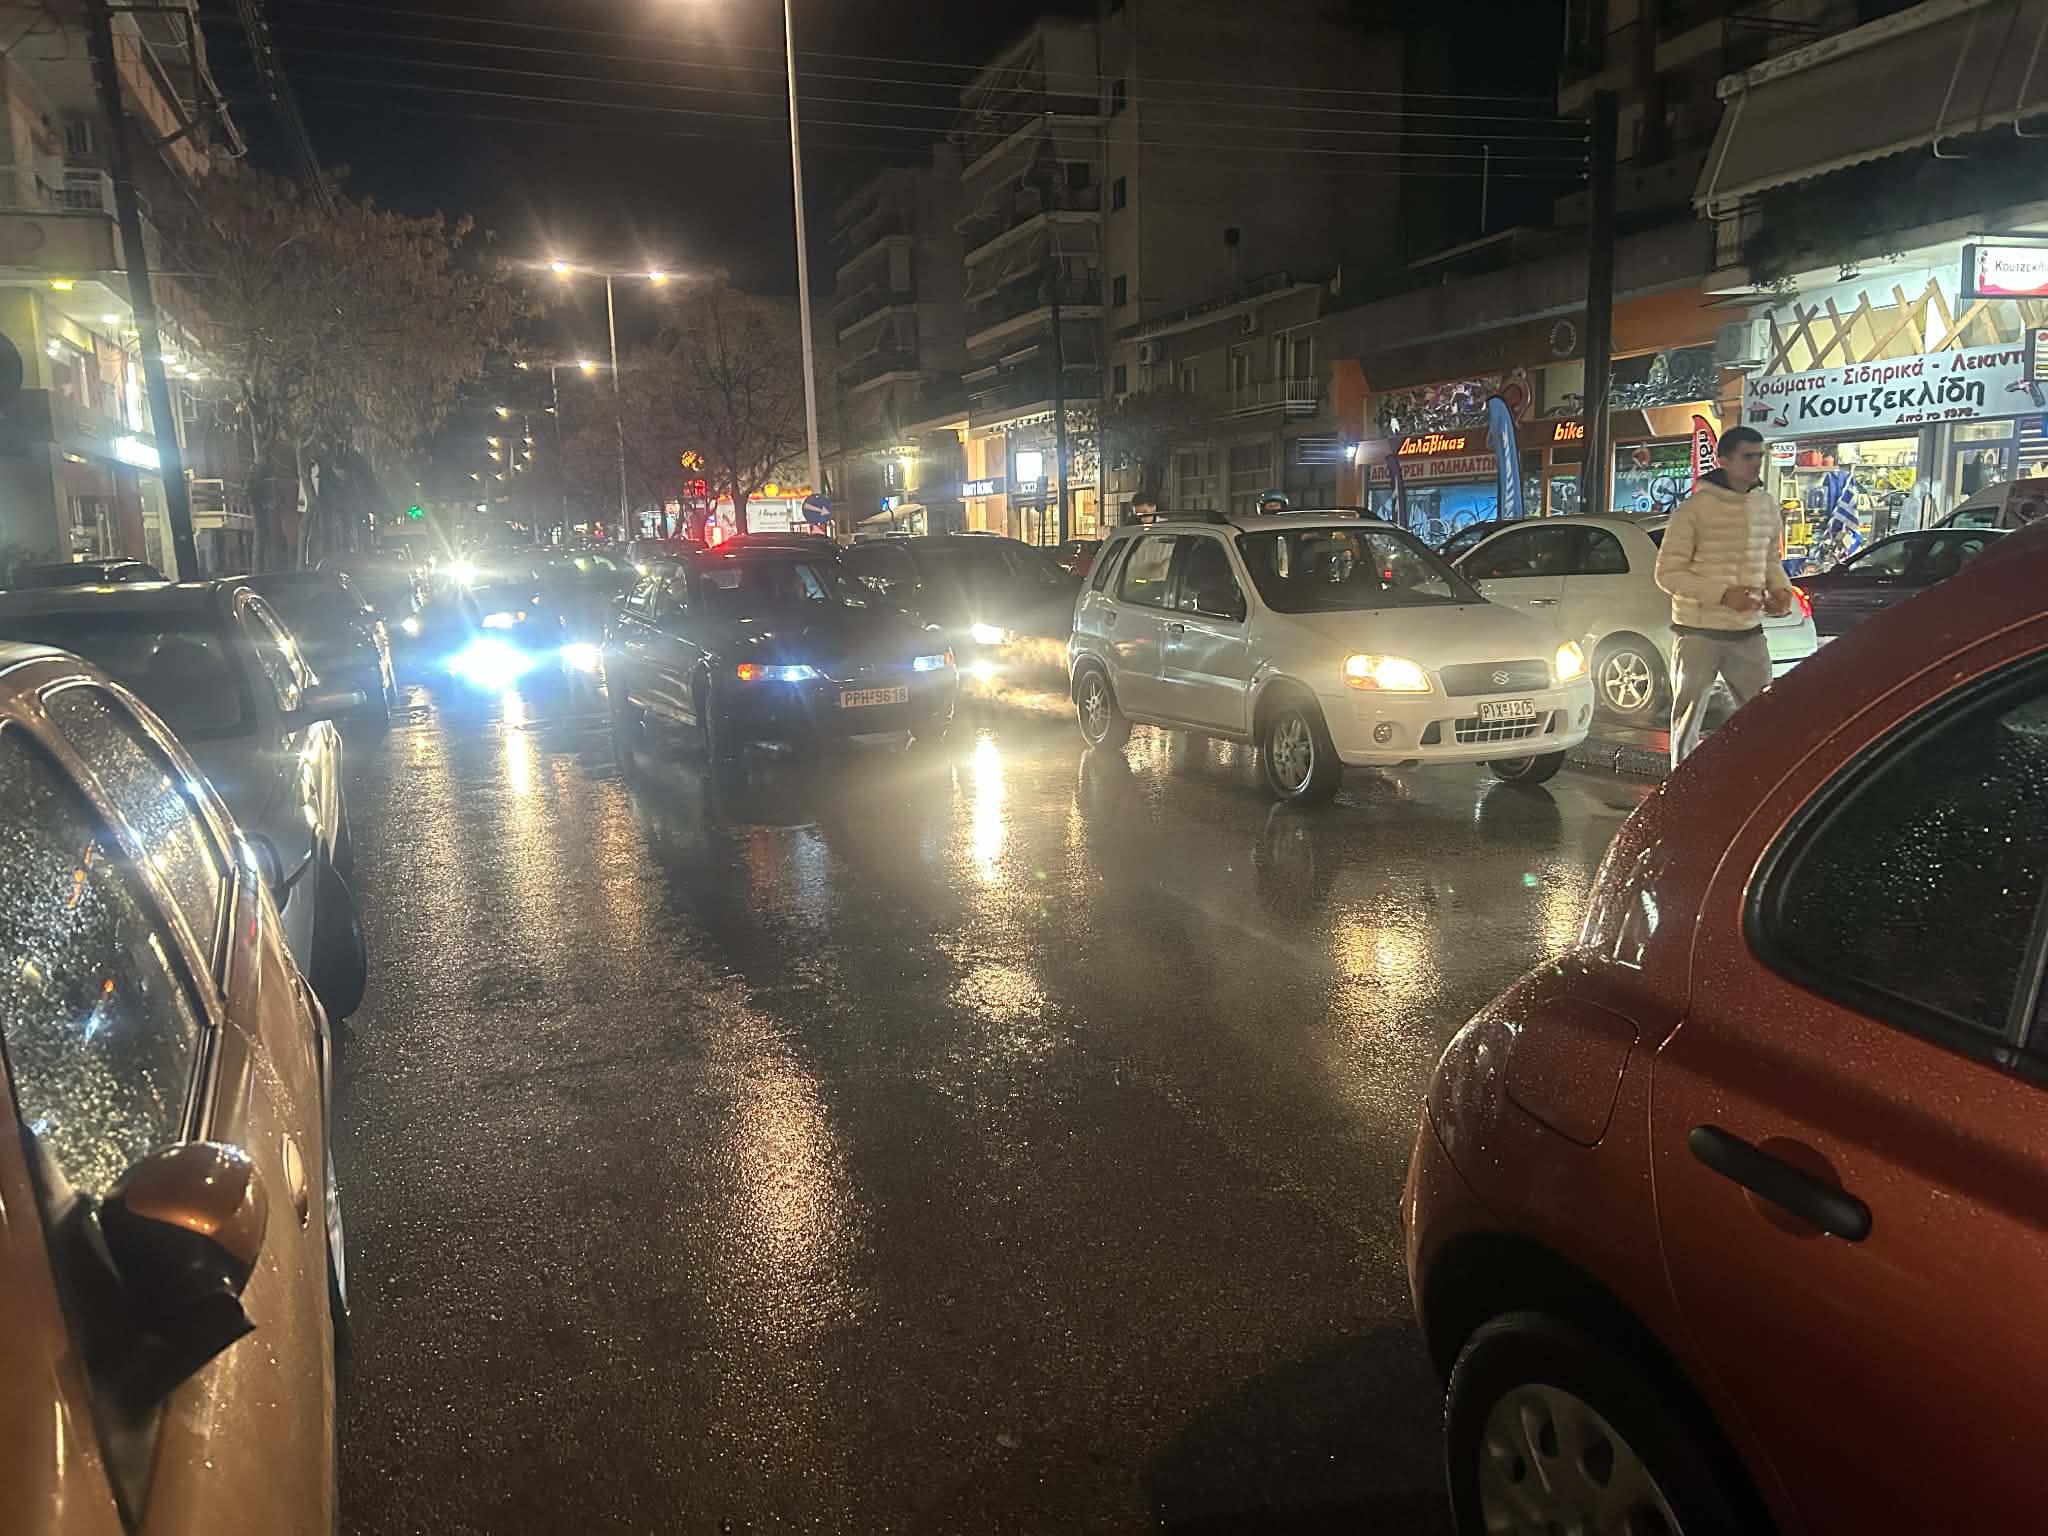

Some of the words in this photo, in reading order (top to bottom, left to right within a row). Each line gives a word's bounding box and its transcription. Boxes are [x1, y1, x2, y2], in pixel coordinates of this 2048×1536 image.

[1749, 375, 1826, 399] Χρώματα
[1843, 357, 1924, 386] Σιδηρικά
[1800, 376, 1985, 419] Κουτζεκλίδη
